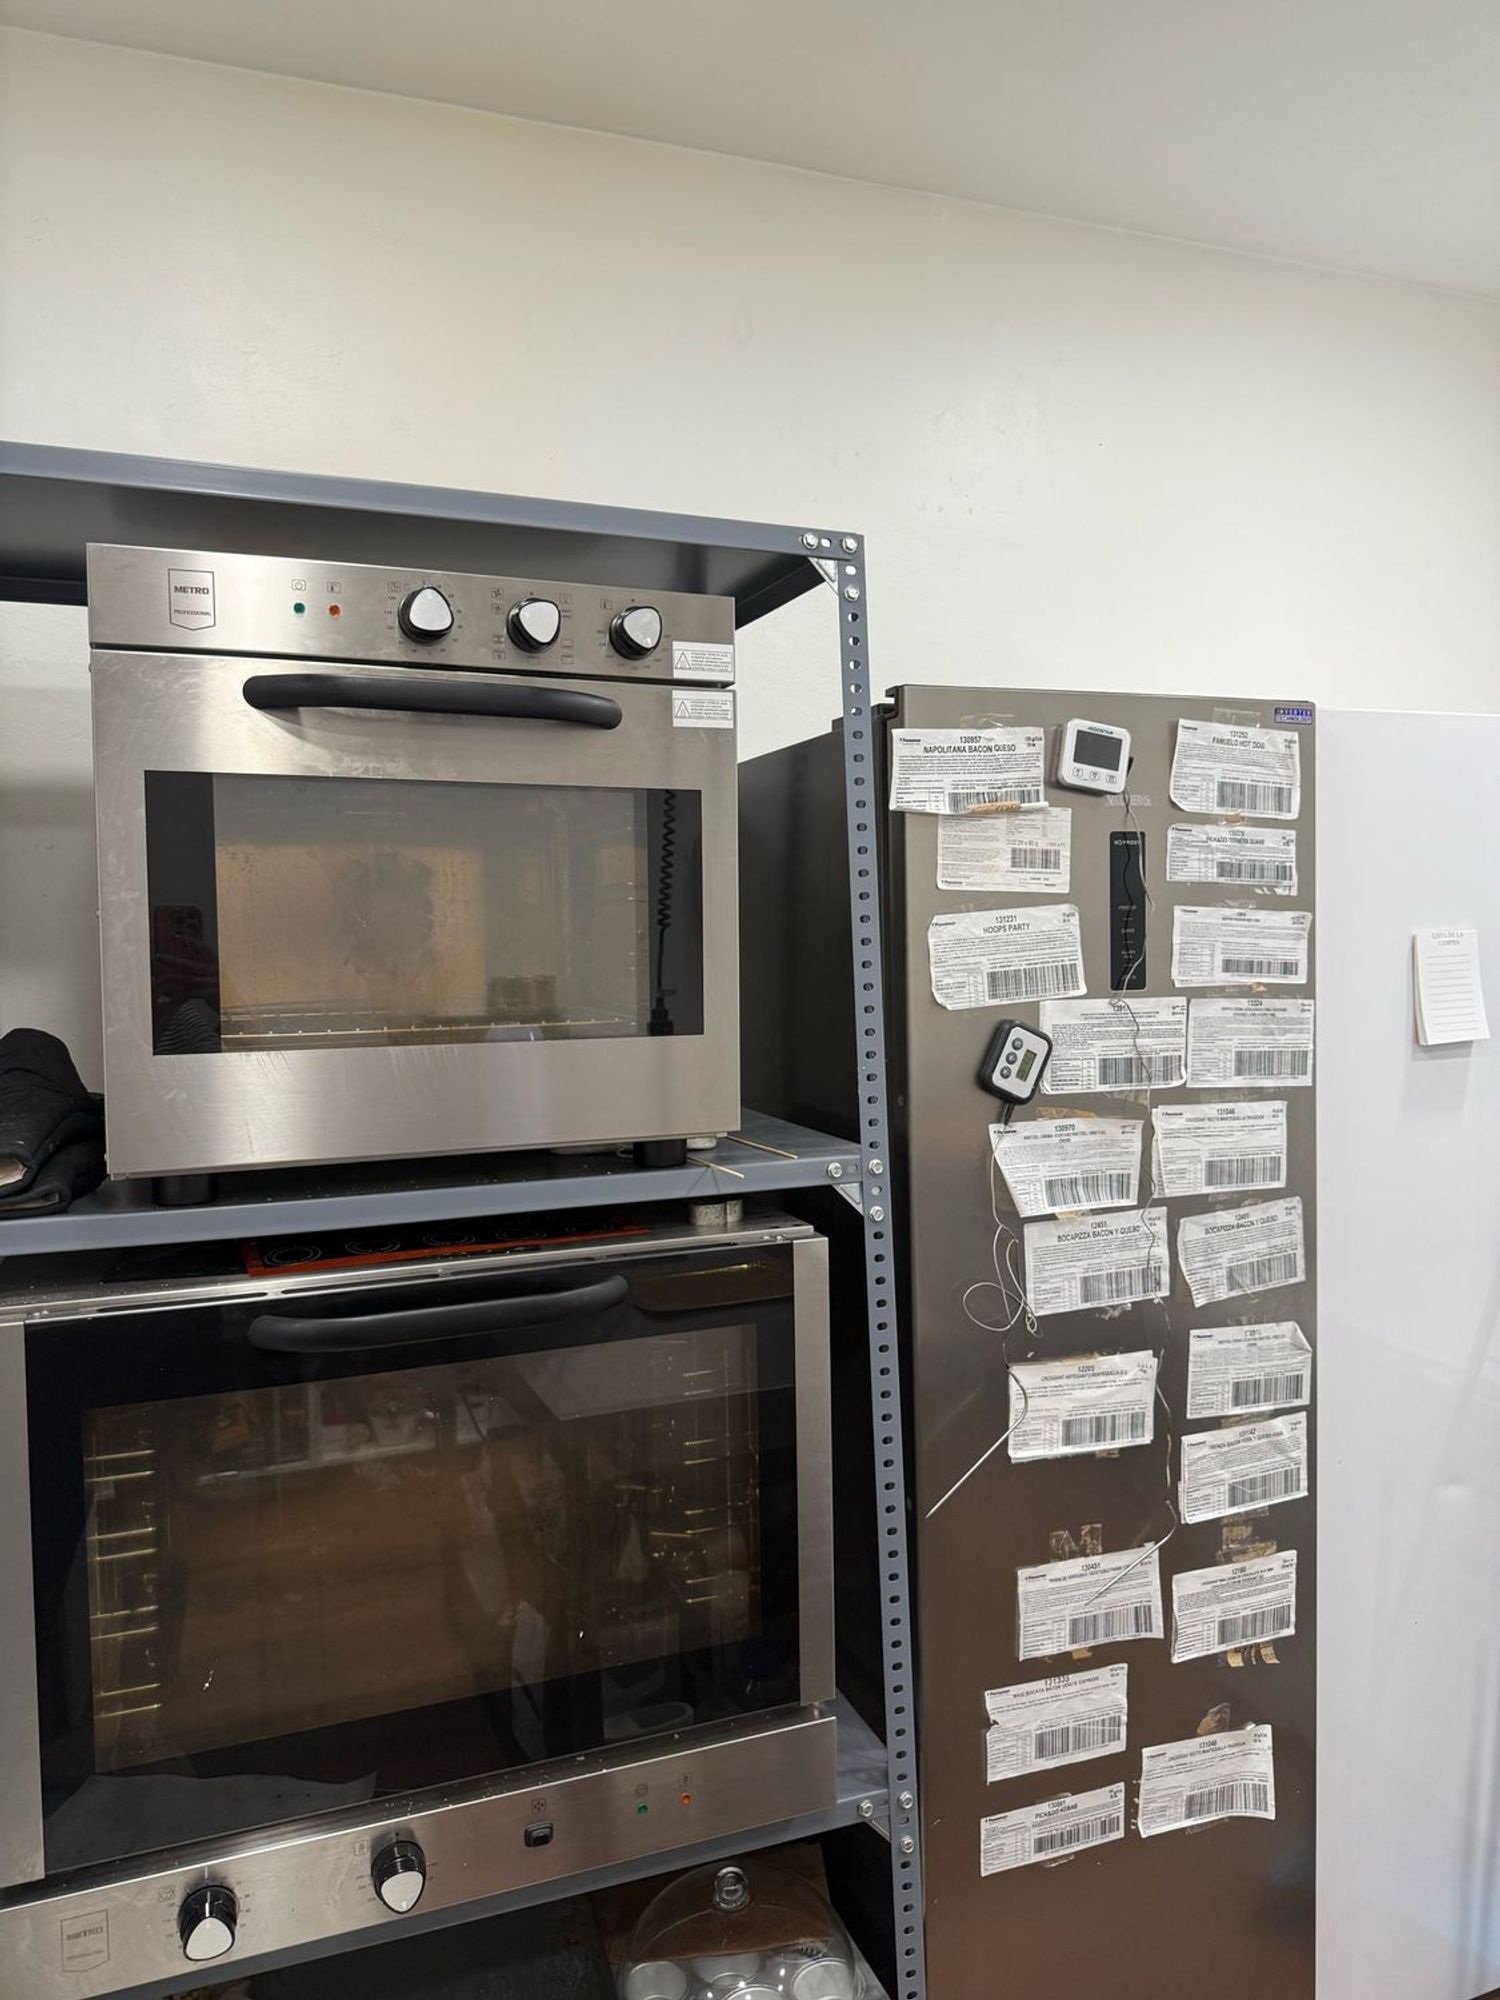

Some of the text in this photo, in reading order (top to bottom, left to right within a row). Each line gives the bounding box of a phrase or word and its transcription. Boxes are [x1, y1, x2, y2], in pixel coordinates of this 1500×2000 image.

[173, 585, 209, 595] METRO
[923, 743, 1016, 754] NAPOLITANA BACON QUESO
[983, 922, 1031, 934] HOOPS PARTY
[66, 1926, 104, 1940] METRO
